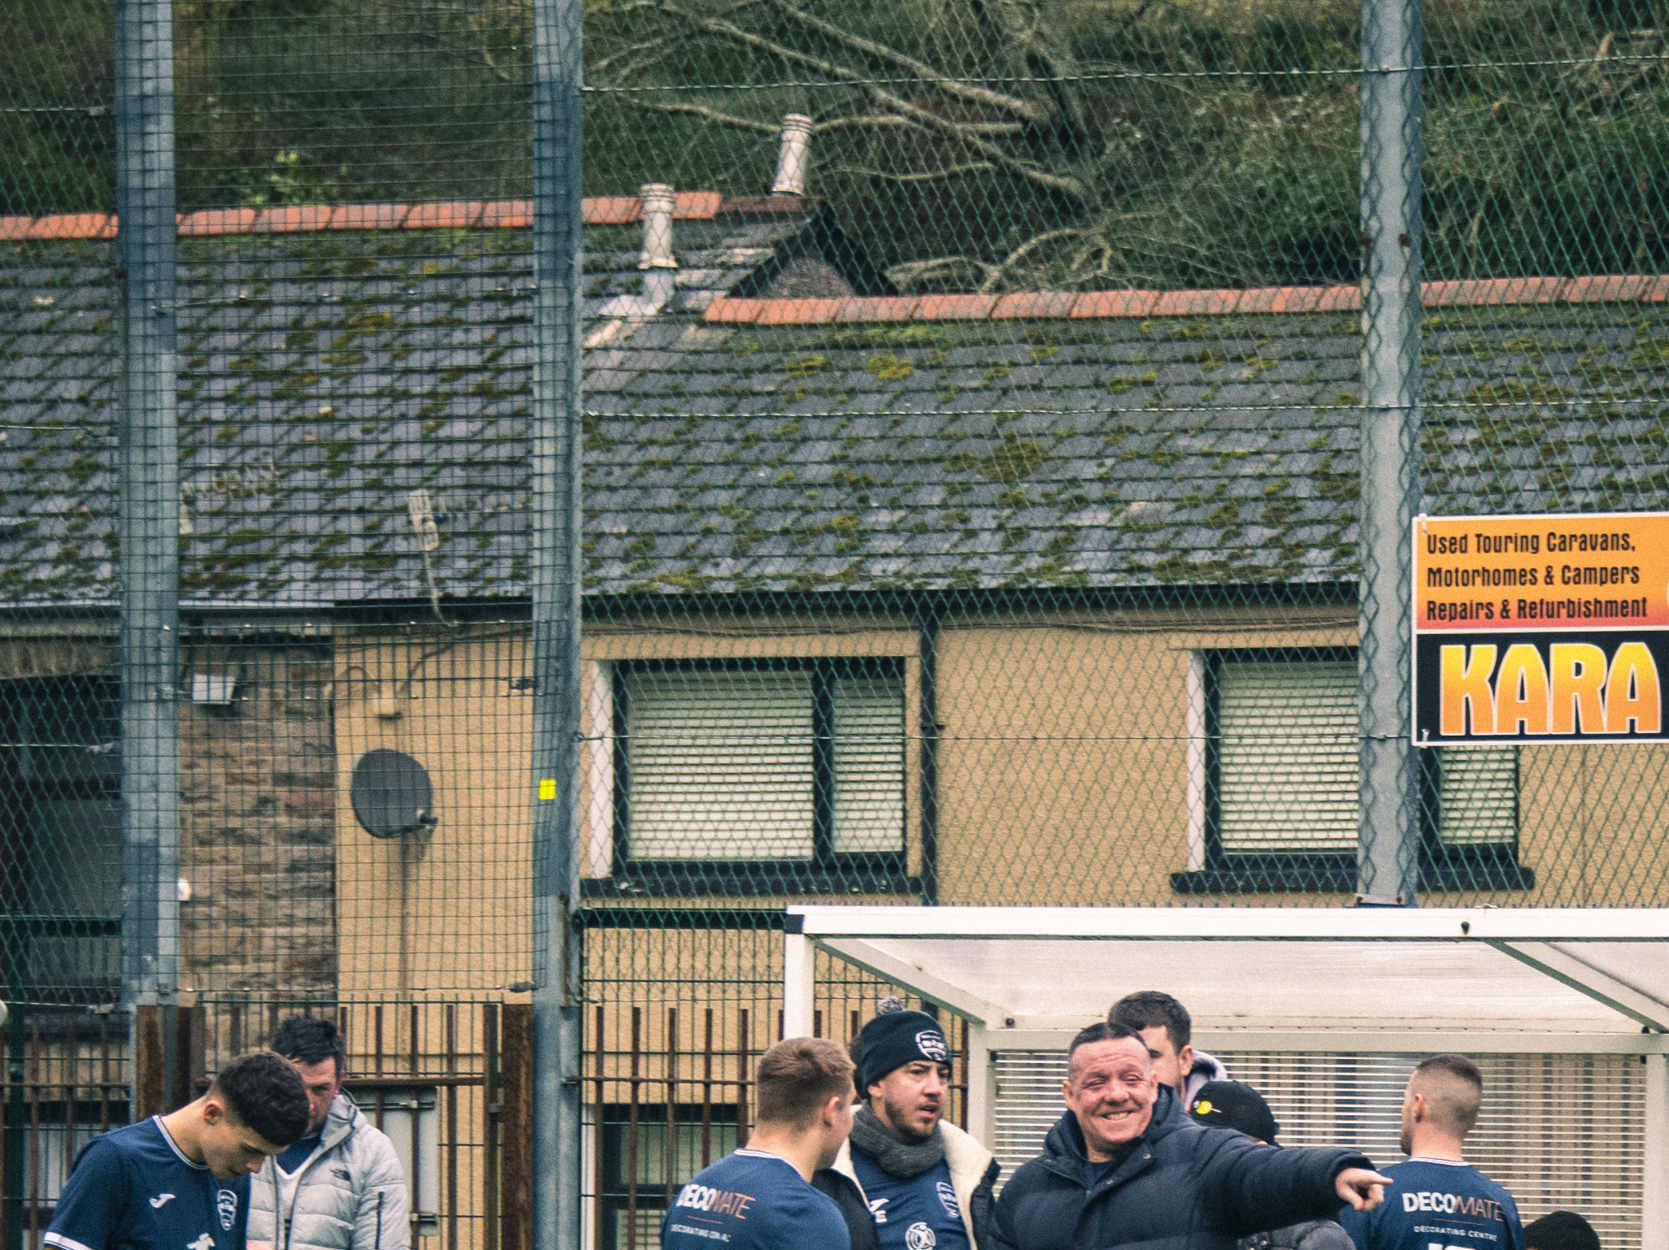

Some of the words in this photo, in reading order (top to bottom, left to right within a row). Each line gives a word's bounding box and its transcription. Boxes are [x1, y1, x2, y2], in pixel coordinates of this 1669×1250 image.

[1427, 533, 1468, 554] Used
[1475, 533, 1540, 555] Touring
[1547, 531, 1636, 552] Caravans,
[1427, 566, 1538, 588] Motorhomes
[1543, 565, 1555, 586] &
[1561, 565, 1641, 586] Campers
[1427, 600, 1495, 622] Repairs
[1500, 598, 1511, 619] &
[1517, 597, 1648, 619] Refurbishment
[1440, 641, 1662, 736] KARA
[1402, 1191, 1505, 1223] DECOMATE
[1413, 1225, 1466, 1236] DECORATING
[1467, 1230, 1498, 1242] CENTRE
